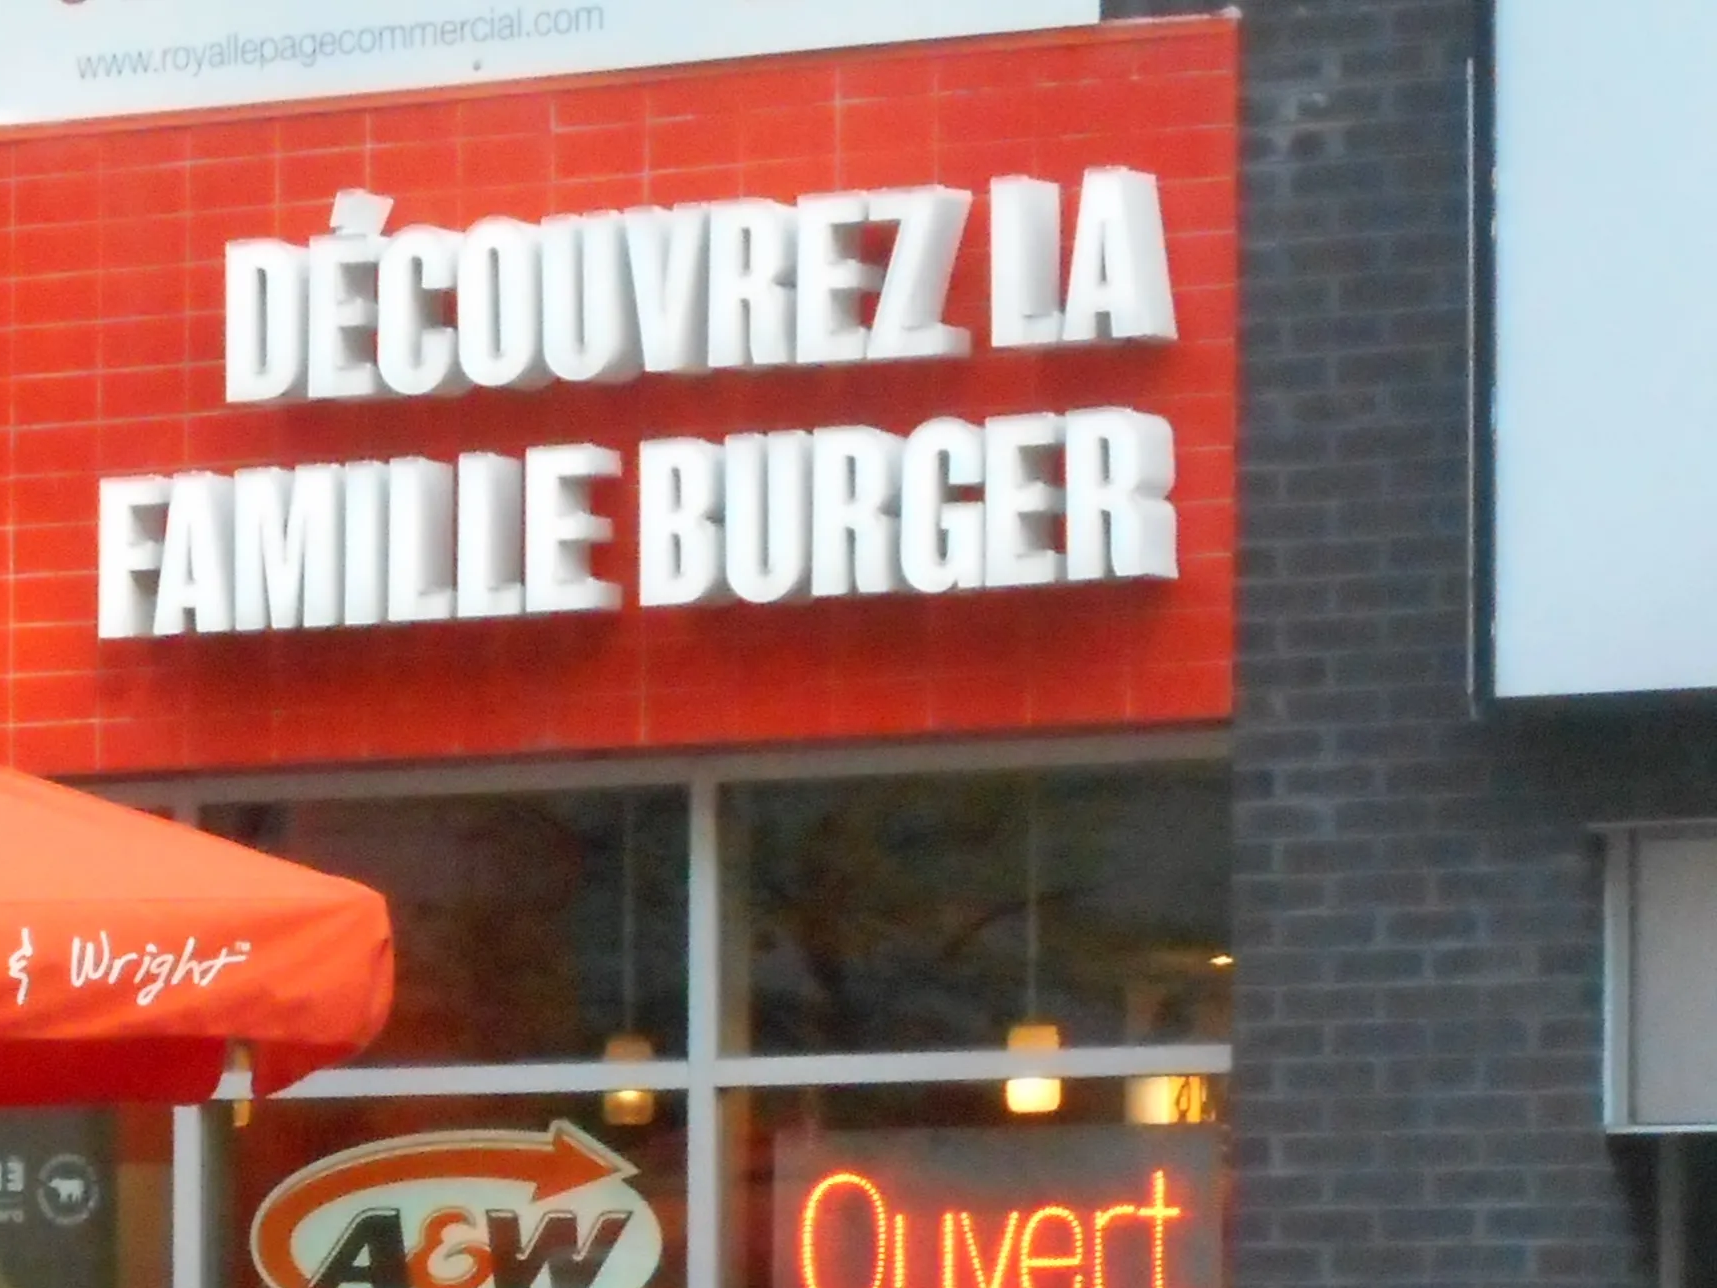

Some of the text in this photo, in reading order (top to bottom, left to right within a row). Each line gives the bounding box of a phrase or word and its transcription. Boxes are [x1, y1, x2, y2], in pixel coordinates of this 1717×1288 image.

[76, 5, 604, 79] www.royallepagecommercial.com
[225, 165, 1178, 403] DÉCOUVREZ LA
[97, 407, 1178, 640] FAMILLE BURGER
[8, 926, 33, 1006] &
